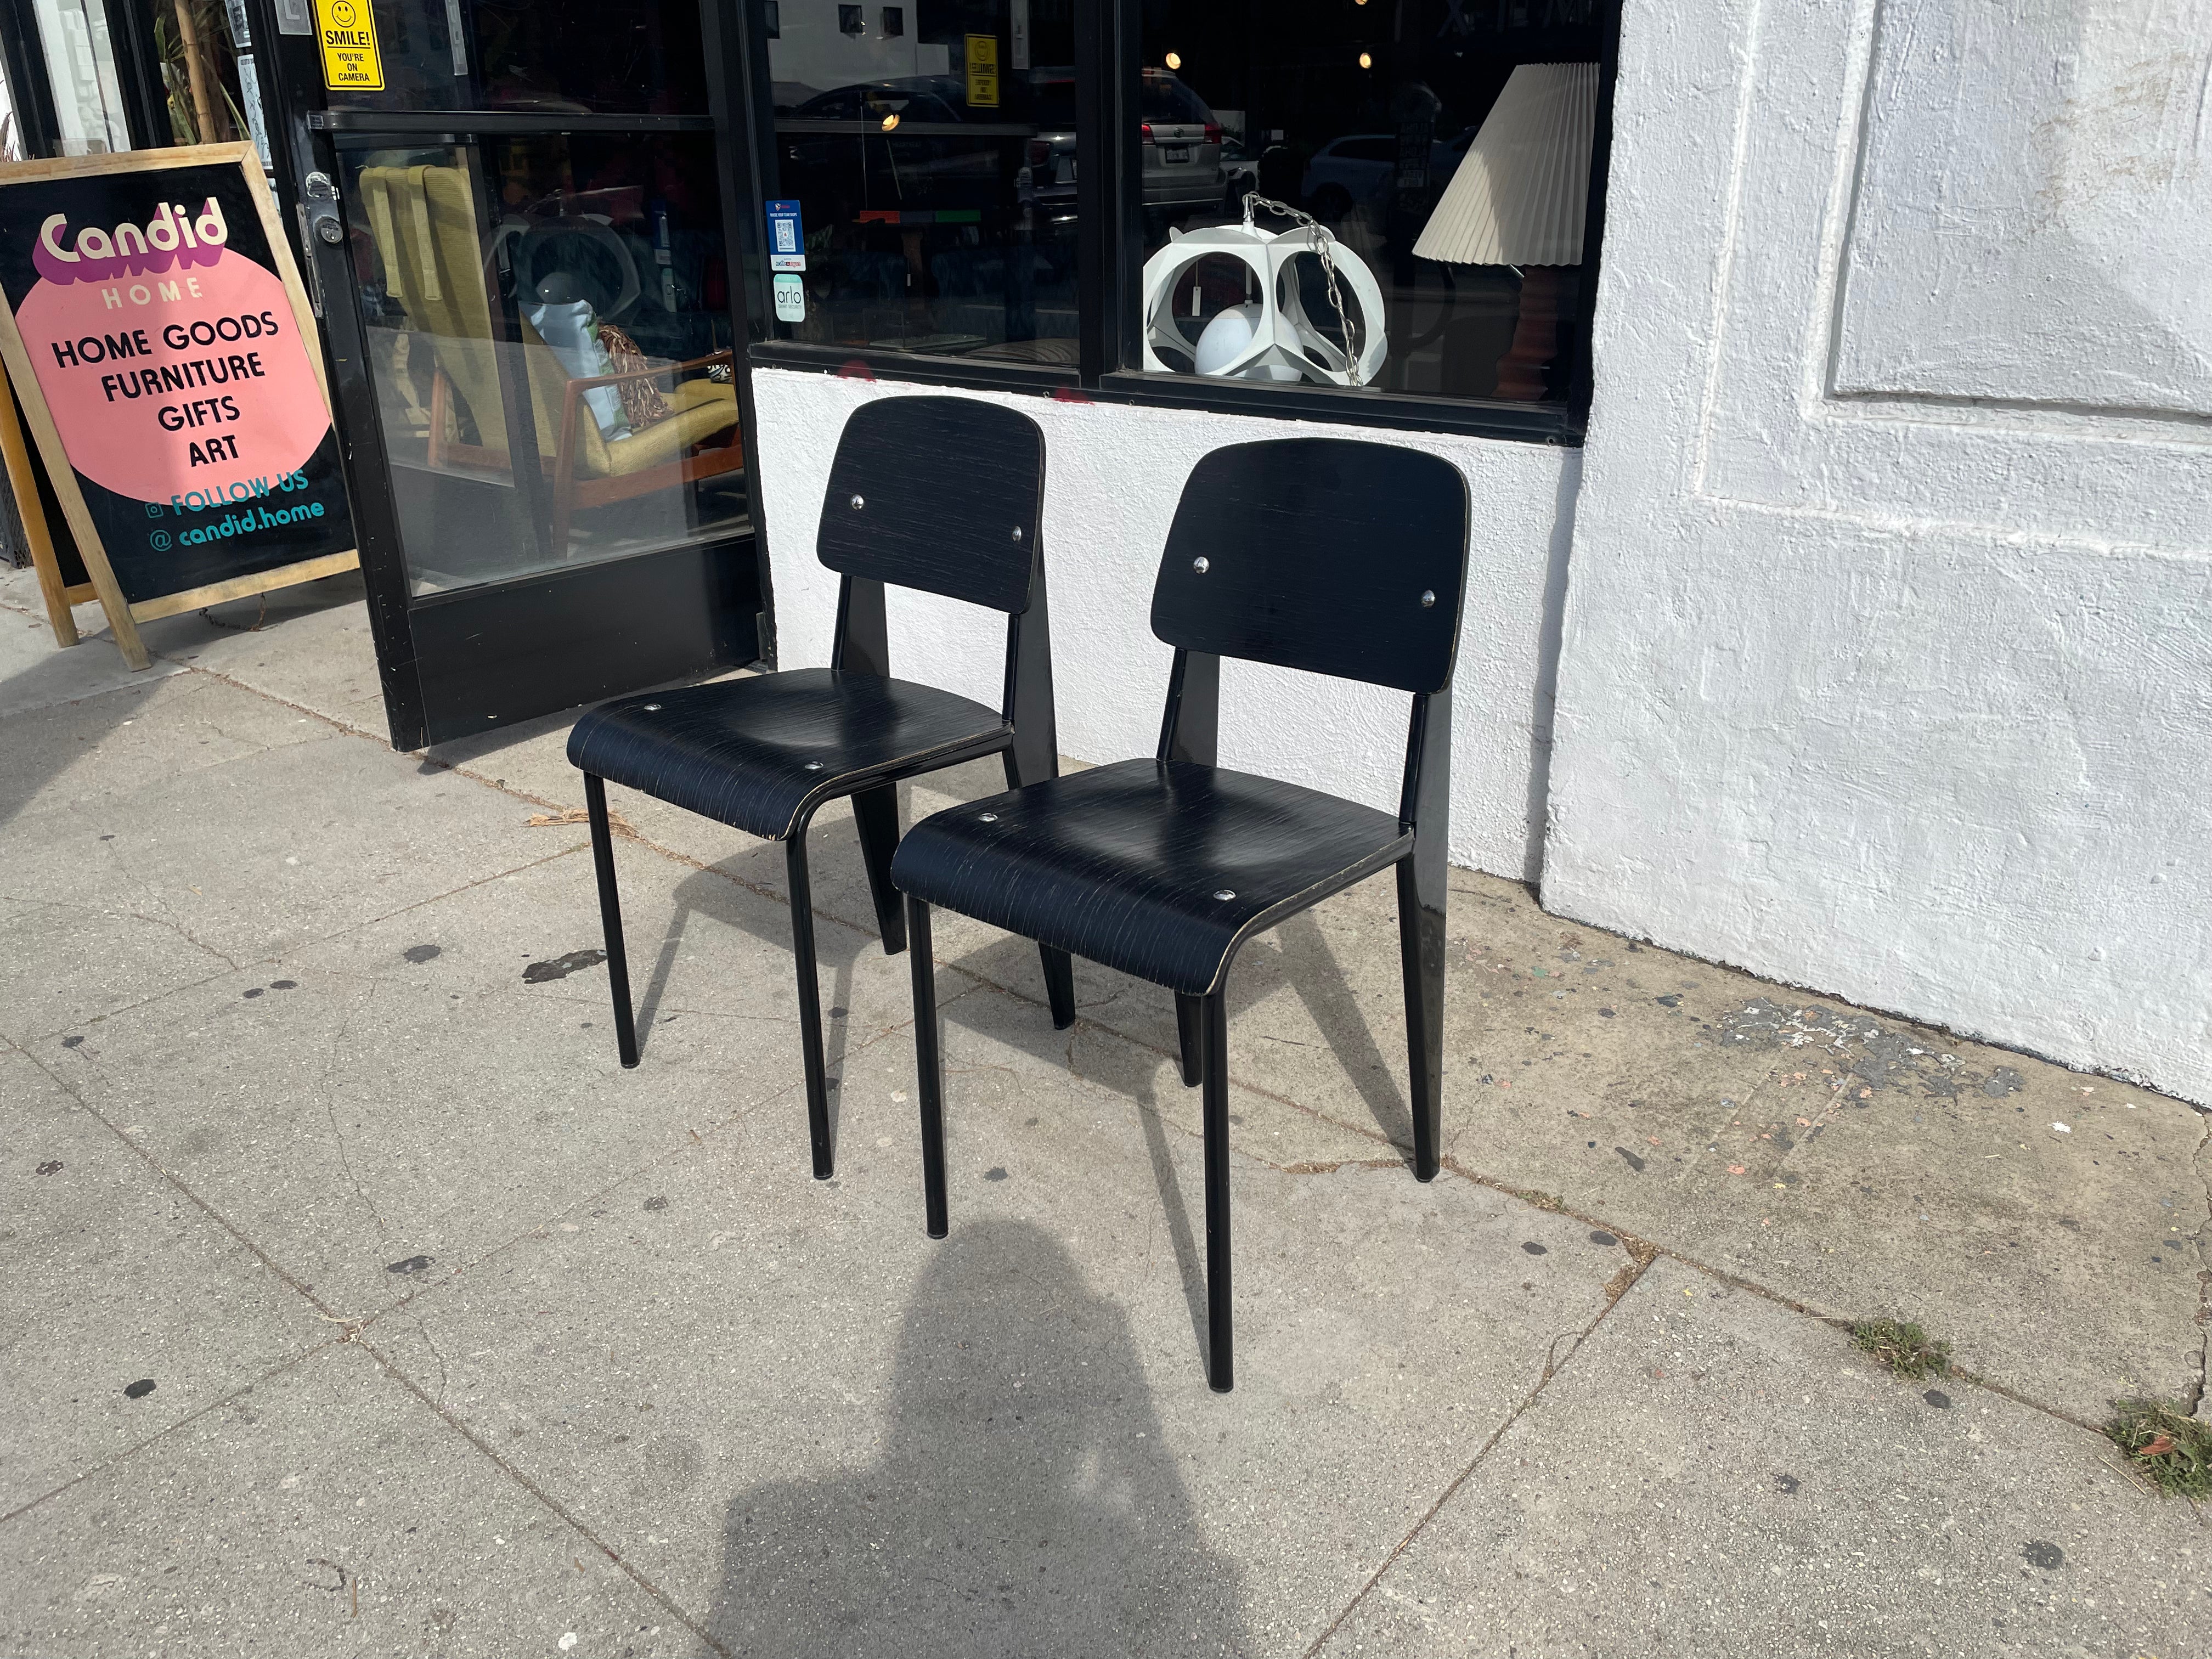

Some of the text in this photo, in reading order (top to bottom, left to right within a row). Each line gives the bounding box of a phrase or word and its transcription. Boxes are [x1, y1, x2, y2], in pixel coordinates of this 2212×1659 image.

[325, 30, 371, 46] SMILE!
[337, 53, 365, 62] YOU'RE
[347, 63, 358, 71] ON
[338, 72, 370, 81] CAMERA
[38, 196, 228, 266] Candid
[101, 276, 203, 309] HOME
[777, 285, 802, 304] arlo
[51, 311, 279, 369] HOME GOODS
[100, 352, 266, 402] FURNITURE
[157, 395, 240, 431] GIFTS
[189, 434, 240, 467] ART
[170, 469, 309, 516] FOLLOW US
[149, 501, 325, 552] @ candid.home
